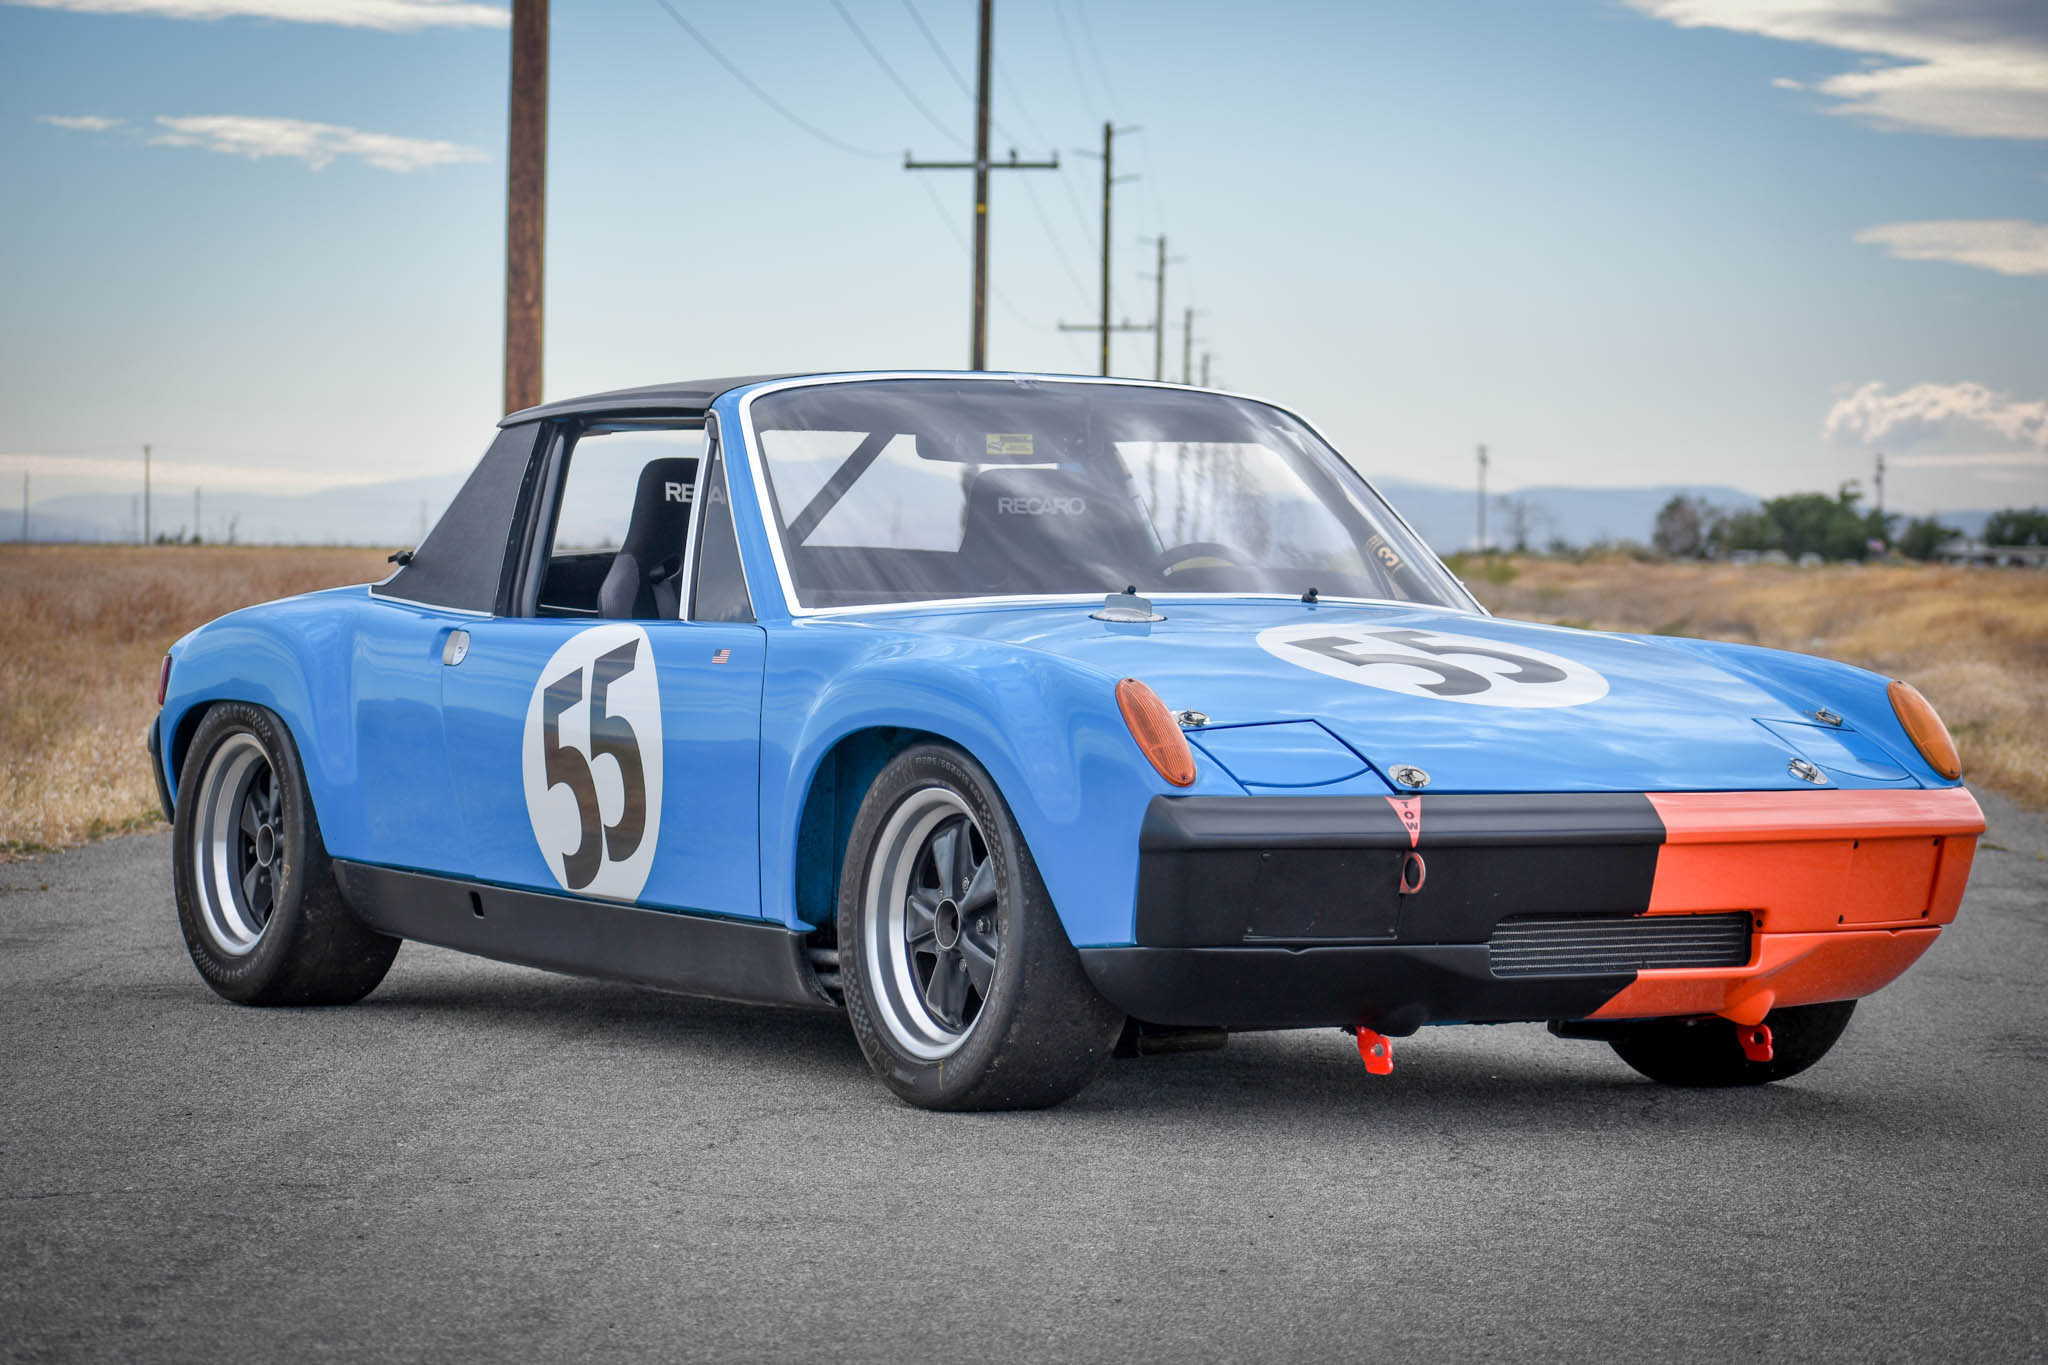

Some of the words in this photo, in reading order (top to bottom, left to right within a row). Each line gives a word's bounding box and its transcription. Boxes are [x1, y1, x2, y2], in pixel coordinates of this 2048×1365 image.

[997, 496, 1086, 515] RECARO
[1285, 629, 1568, 696] 55
[542, 638, 647, 890] 55
[1400, 800, 1419, 831] TOW
